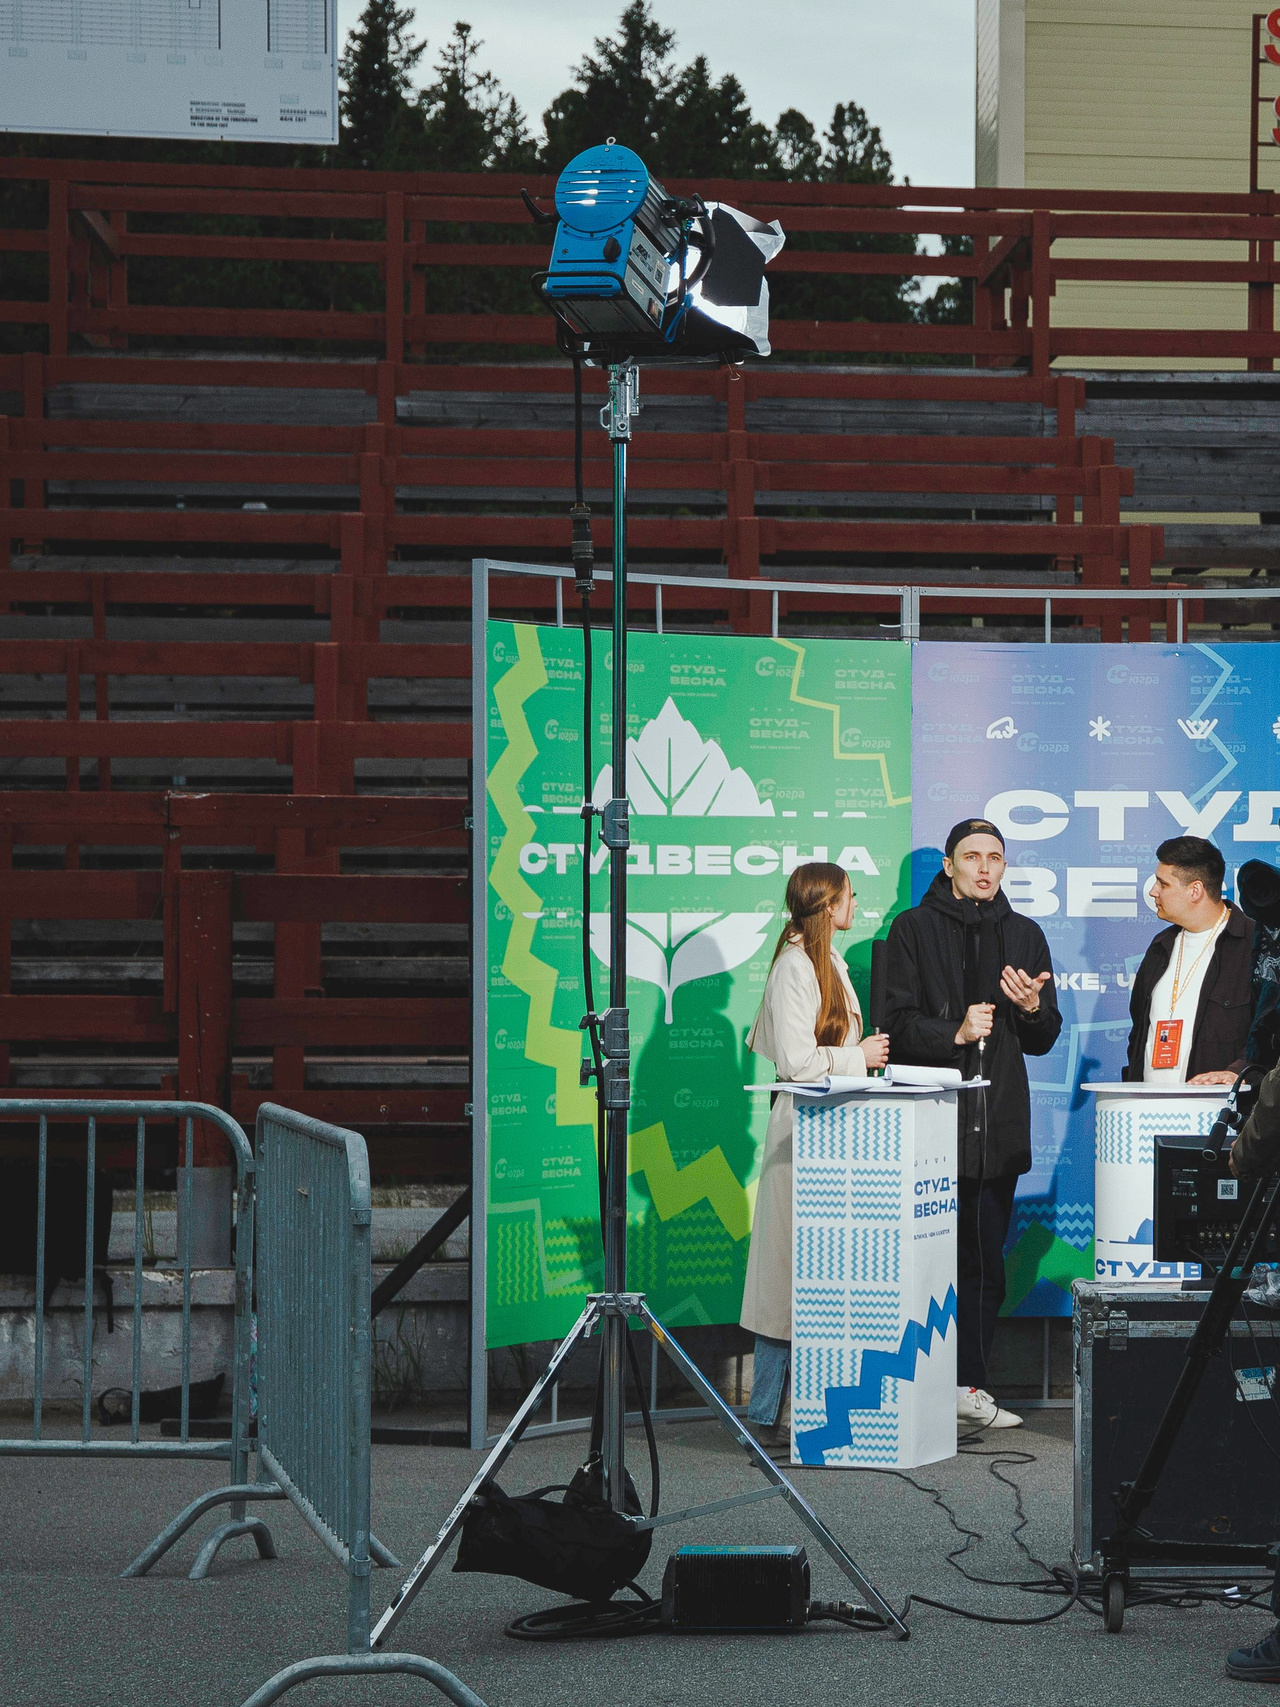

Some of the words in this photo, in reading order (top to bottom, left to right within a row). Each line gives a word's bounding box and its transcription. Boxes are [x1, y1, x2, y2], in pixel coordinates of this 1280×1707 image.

[519, 843, 880, 876] СТУДВЕСНА
[914, 1176, 957, 1196] СТУД-
[914, 1198, 957, 1218] ВЕСНА
